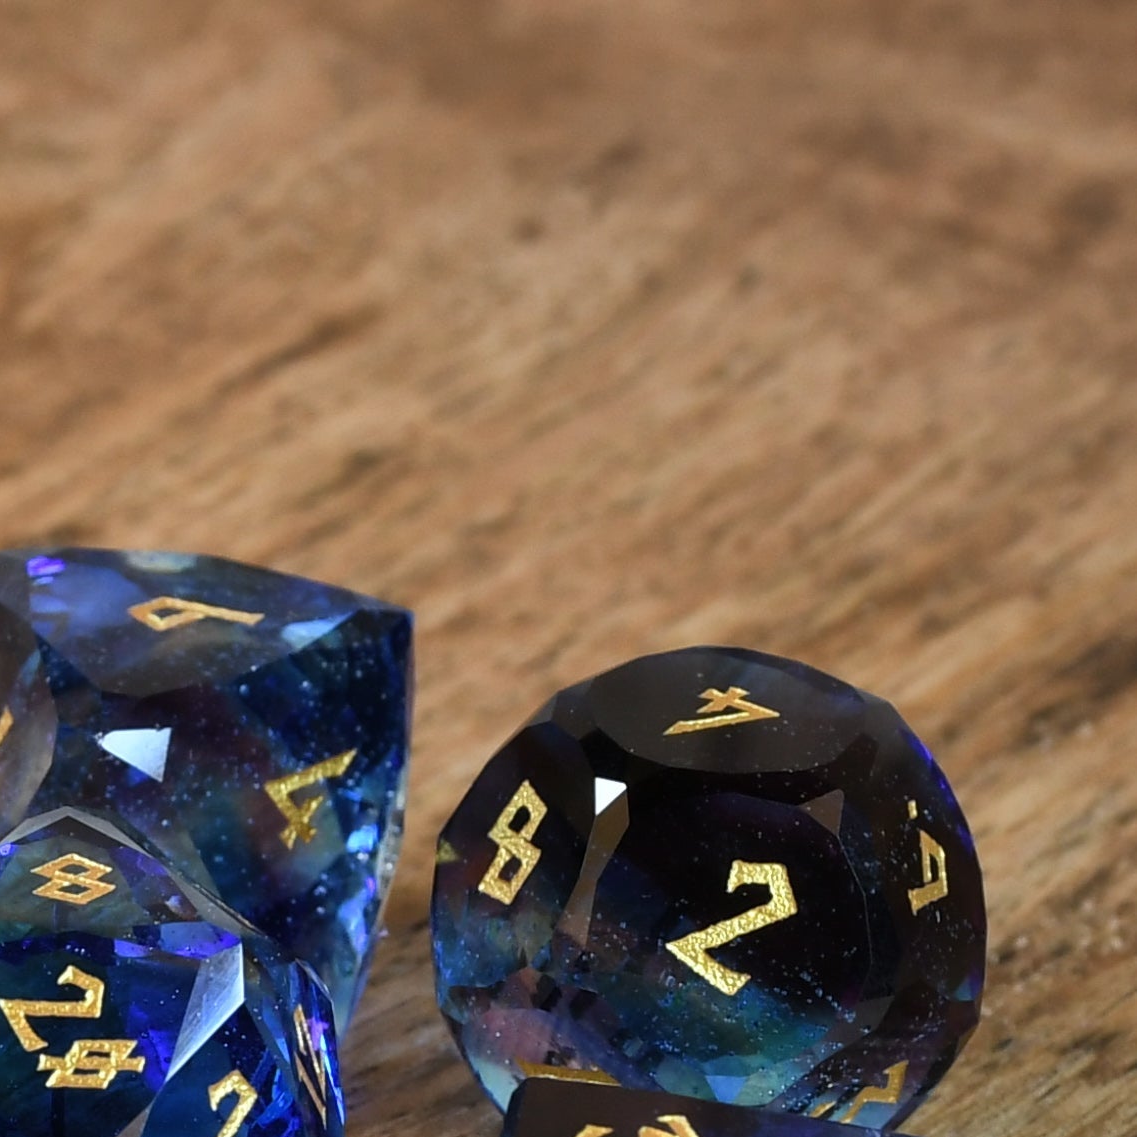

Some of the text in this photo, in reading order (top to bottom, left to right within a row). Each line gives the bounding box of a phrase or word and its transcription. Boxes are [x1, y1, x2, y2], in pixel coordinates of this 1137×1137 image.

[663, 687, 780, 735] 4
[265, 749, 358, 850] 4
[478, 780, 548, 904] 8
[30, 853, 116, 904] 8
[665, 860, 799, 996] 2
